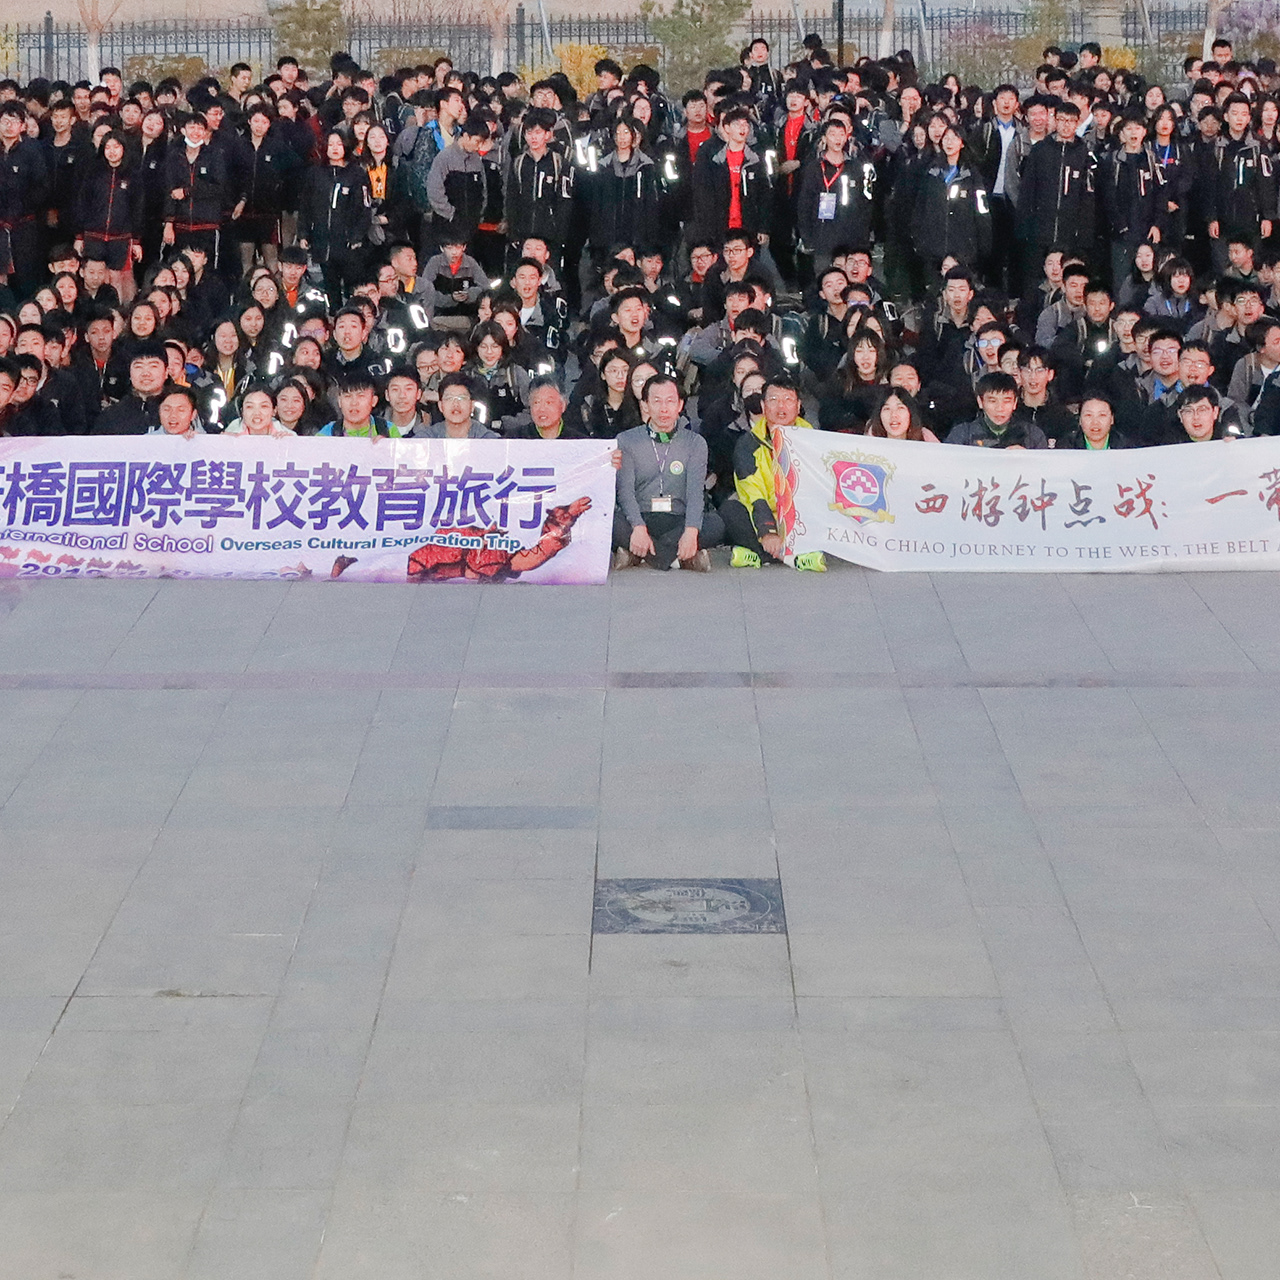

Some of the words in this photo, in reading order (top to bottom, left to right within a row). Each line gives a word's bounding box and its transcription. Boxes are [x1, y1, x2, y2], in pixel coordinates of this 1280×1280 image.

[133, 533, 214, 553] School
[220, 537, 302, 551] Overseas
[307, 537, 376, 550] Cultural
[381, 534, 481, 549] Exploration
[827, 527, 878, 547] KANG
[885, 538, 945, 554] CHIAO
[950, 543, 1037, 558] JOURNEY
[1044, 546, 1069, 558] TO
[1075, 546, 1112, 559] THE
[1119, 545, 1178, 558] WEST,
[1183, 541, 1220, 555] THE
[1227, 539, 1270, 554] BELT
